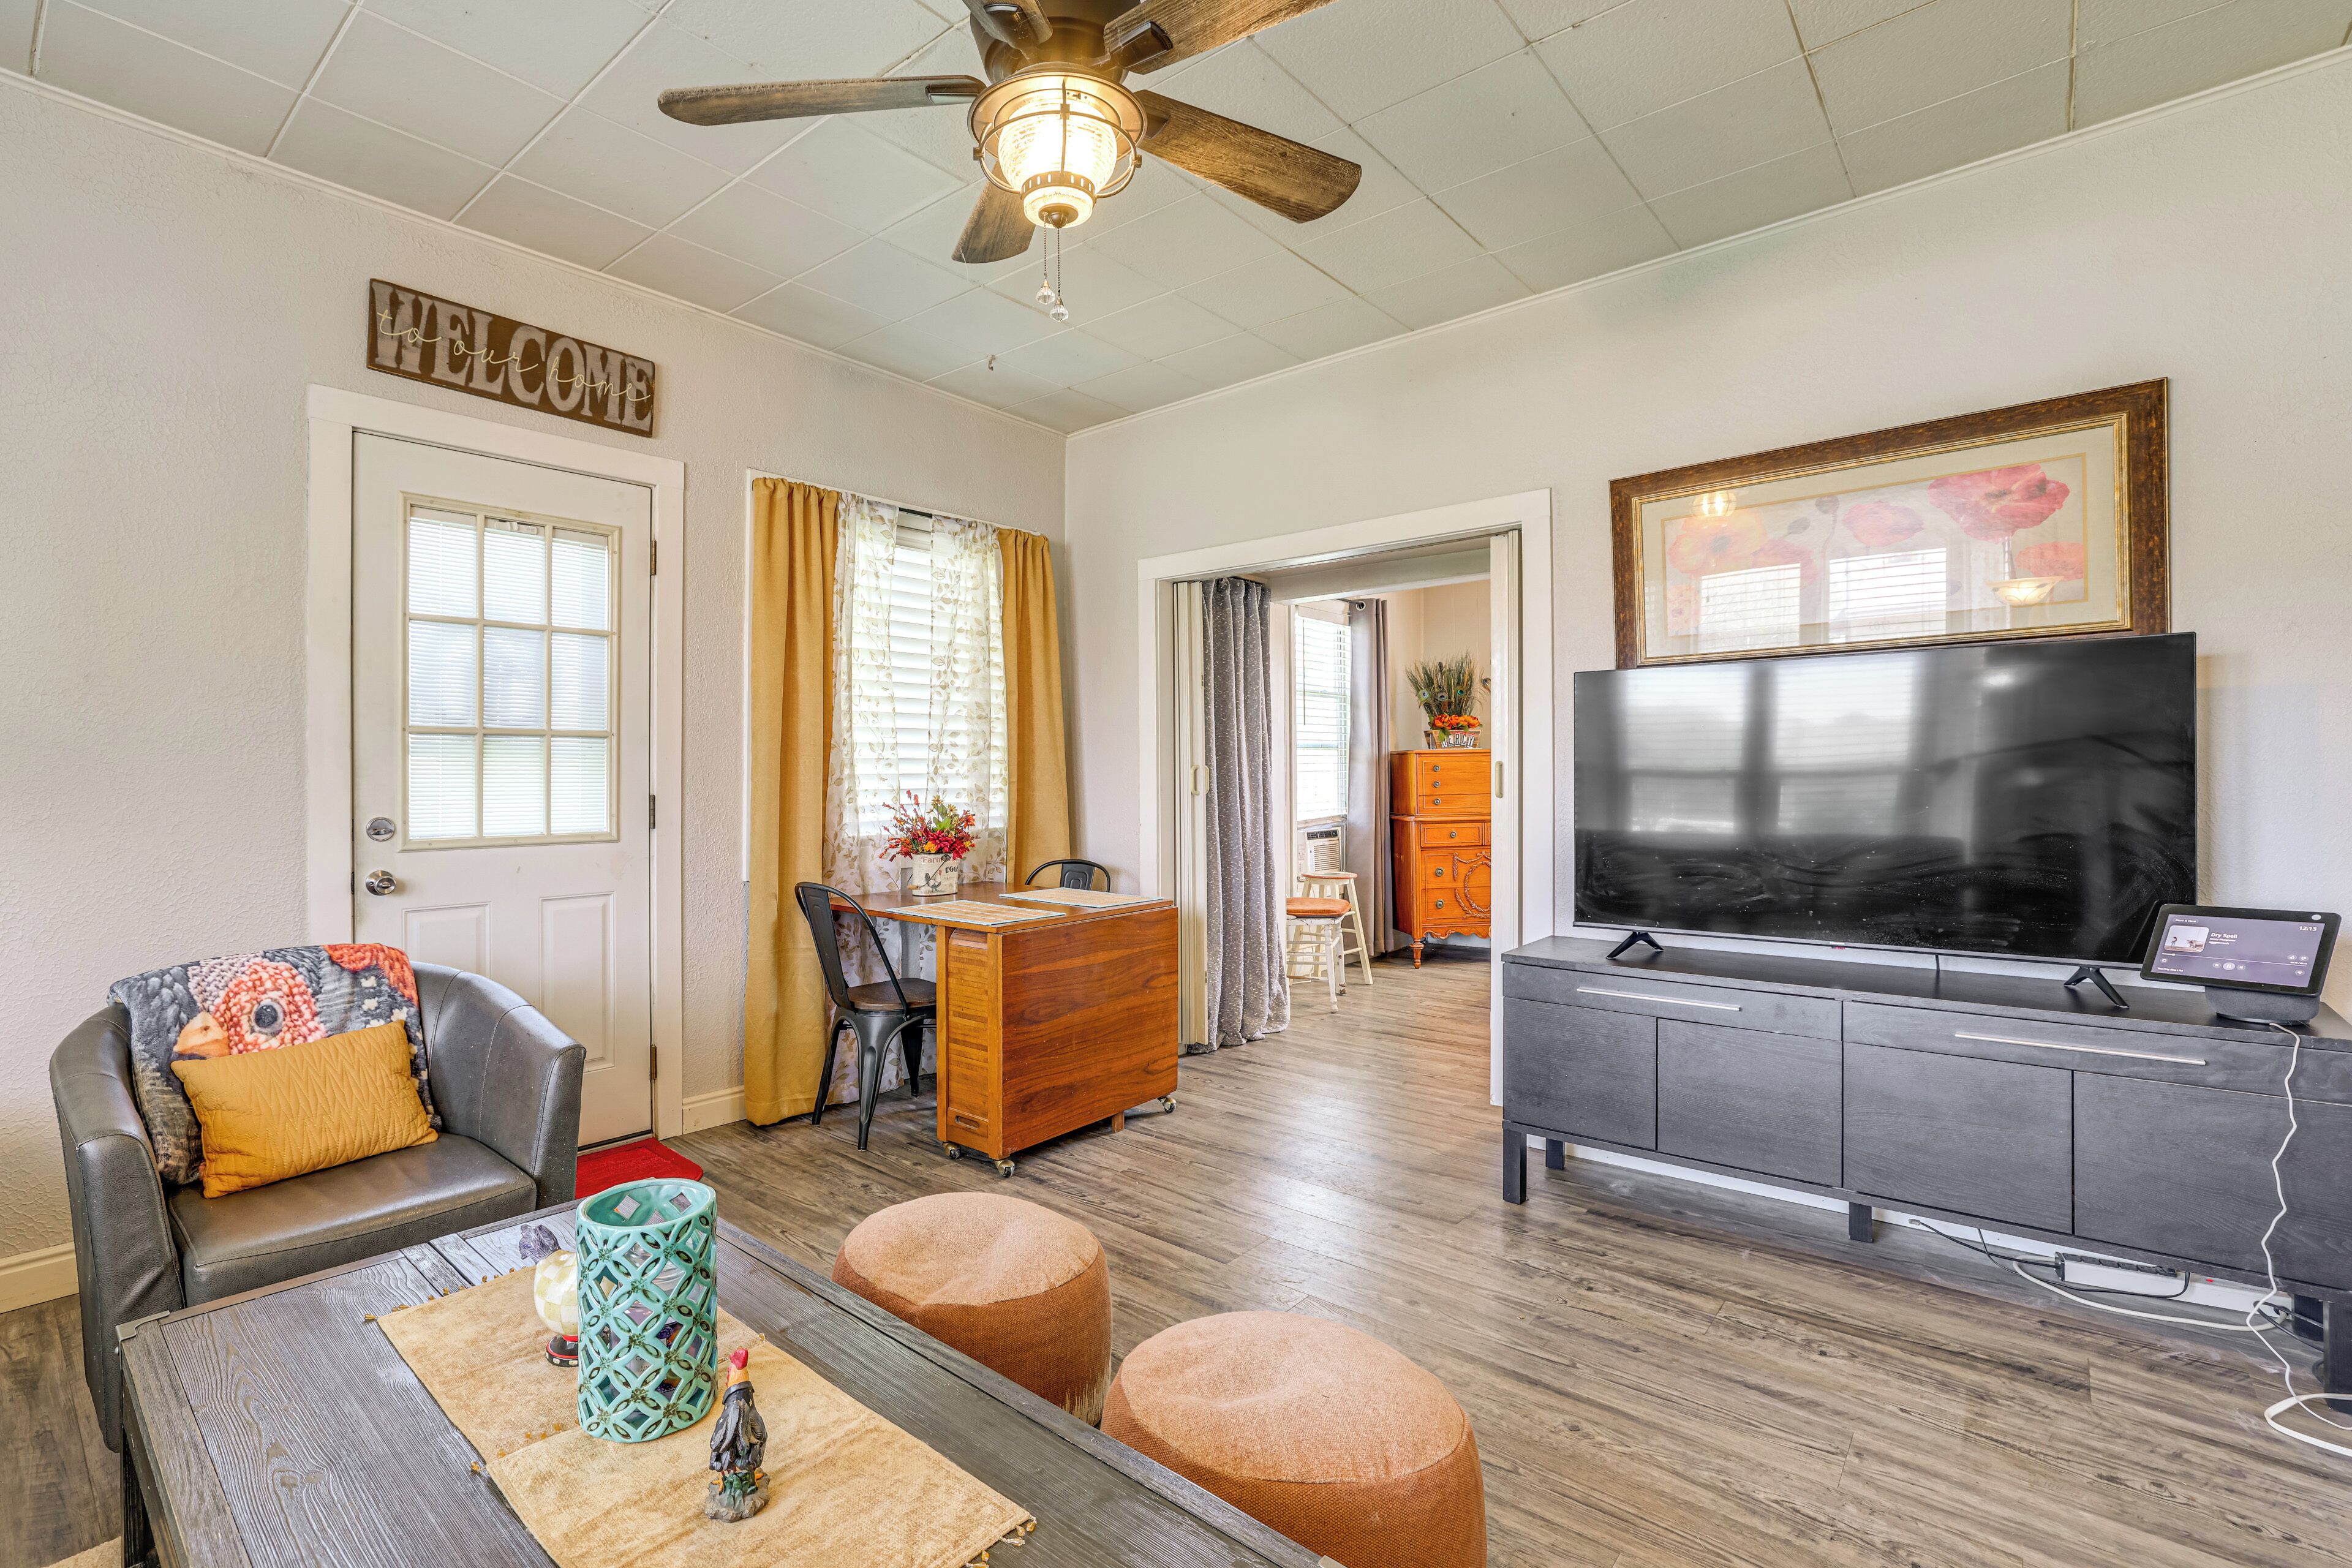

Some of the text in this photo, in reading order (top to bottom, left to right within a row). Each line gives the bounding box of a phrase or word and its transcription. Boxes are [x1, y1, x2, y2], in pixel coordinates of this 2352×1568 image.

[371, 282, 653, 431] WELCOME
[377, 309, 652, 402] to our home
